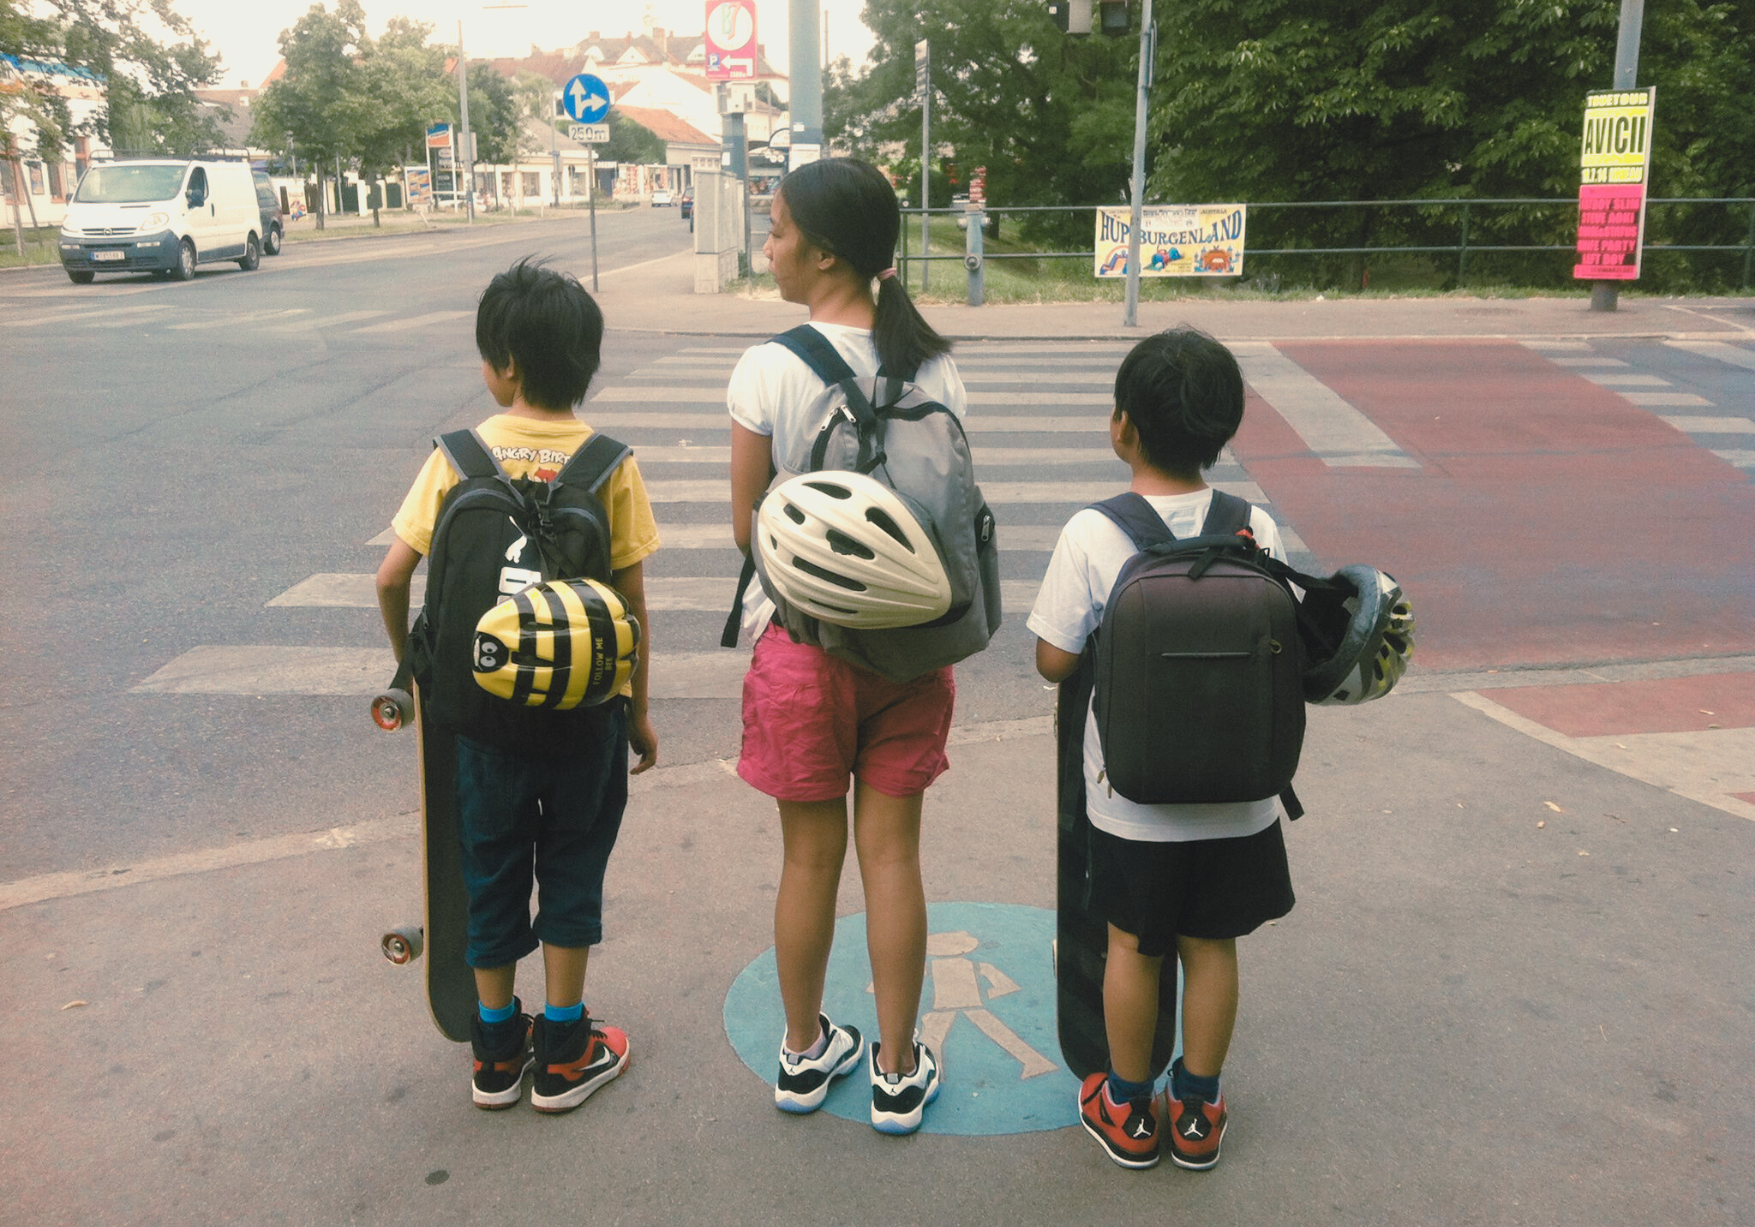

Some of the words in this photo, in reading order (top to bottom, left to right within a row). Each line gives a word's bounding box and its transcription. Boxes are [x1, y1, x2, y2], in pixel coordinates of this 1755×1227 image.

[1584, 116, 1646, 154] AVICII
[492, 445, 537, 462] ANGRY
[594, 637, 604, 650] ME
[592, 652, 604, 686] FOLLOW
